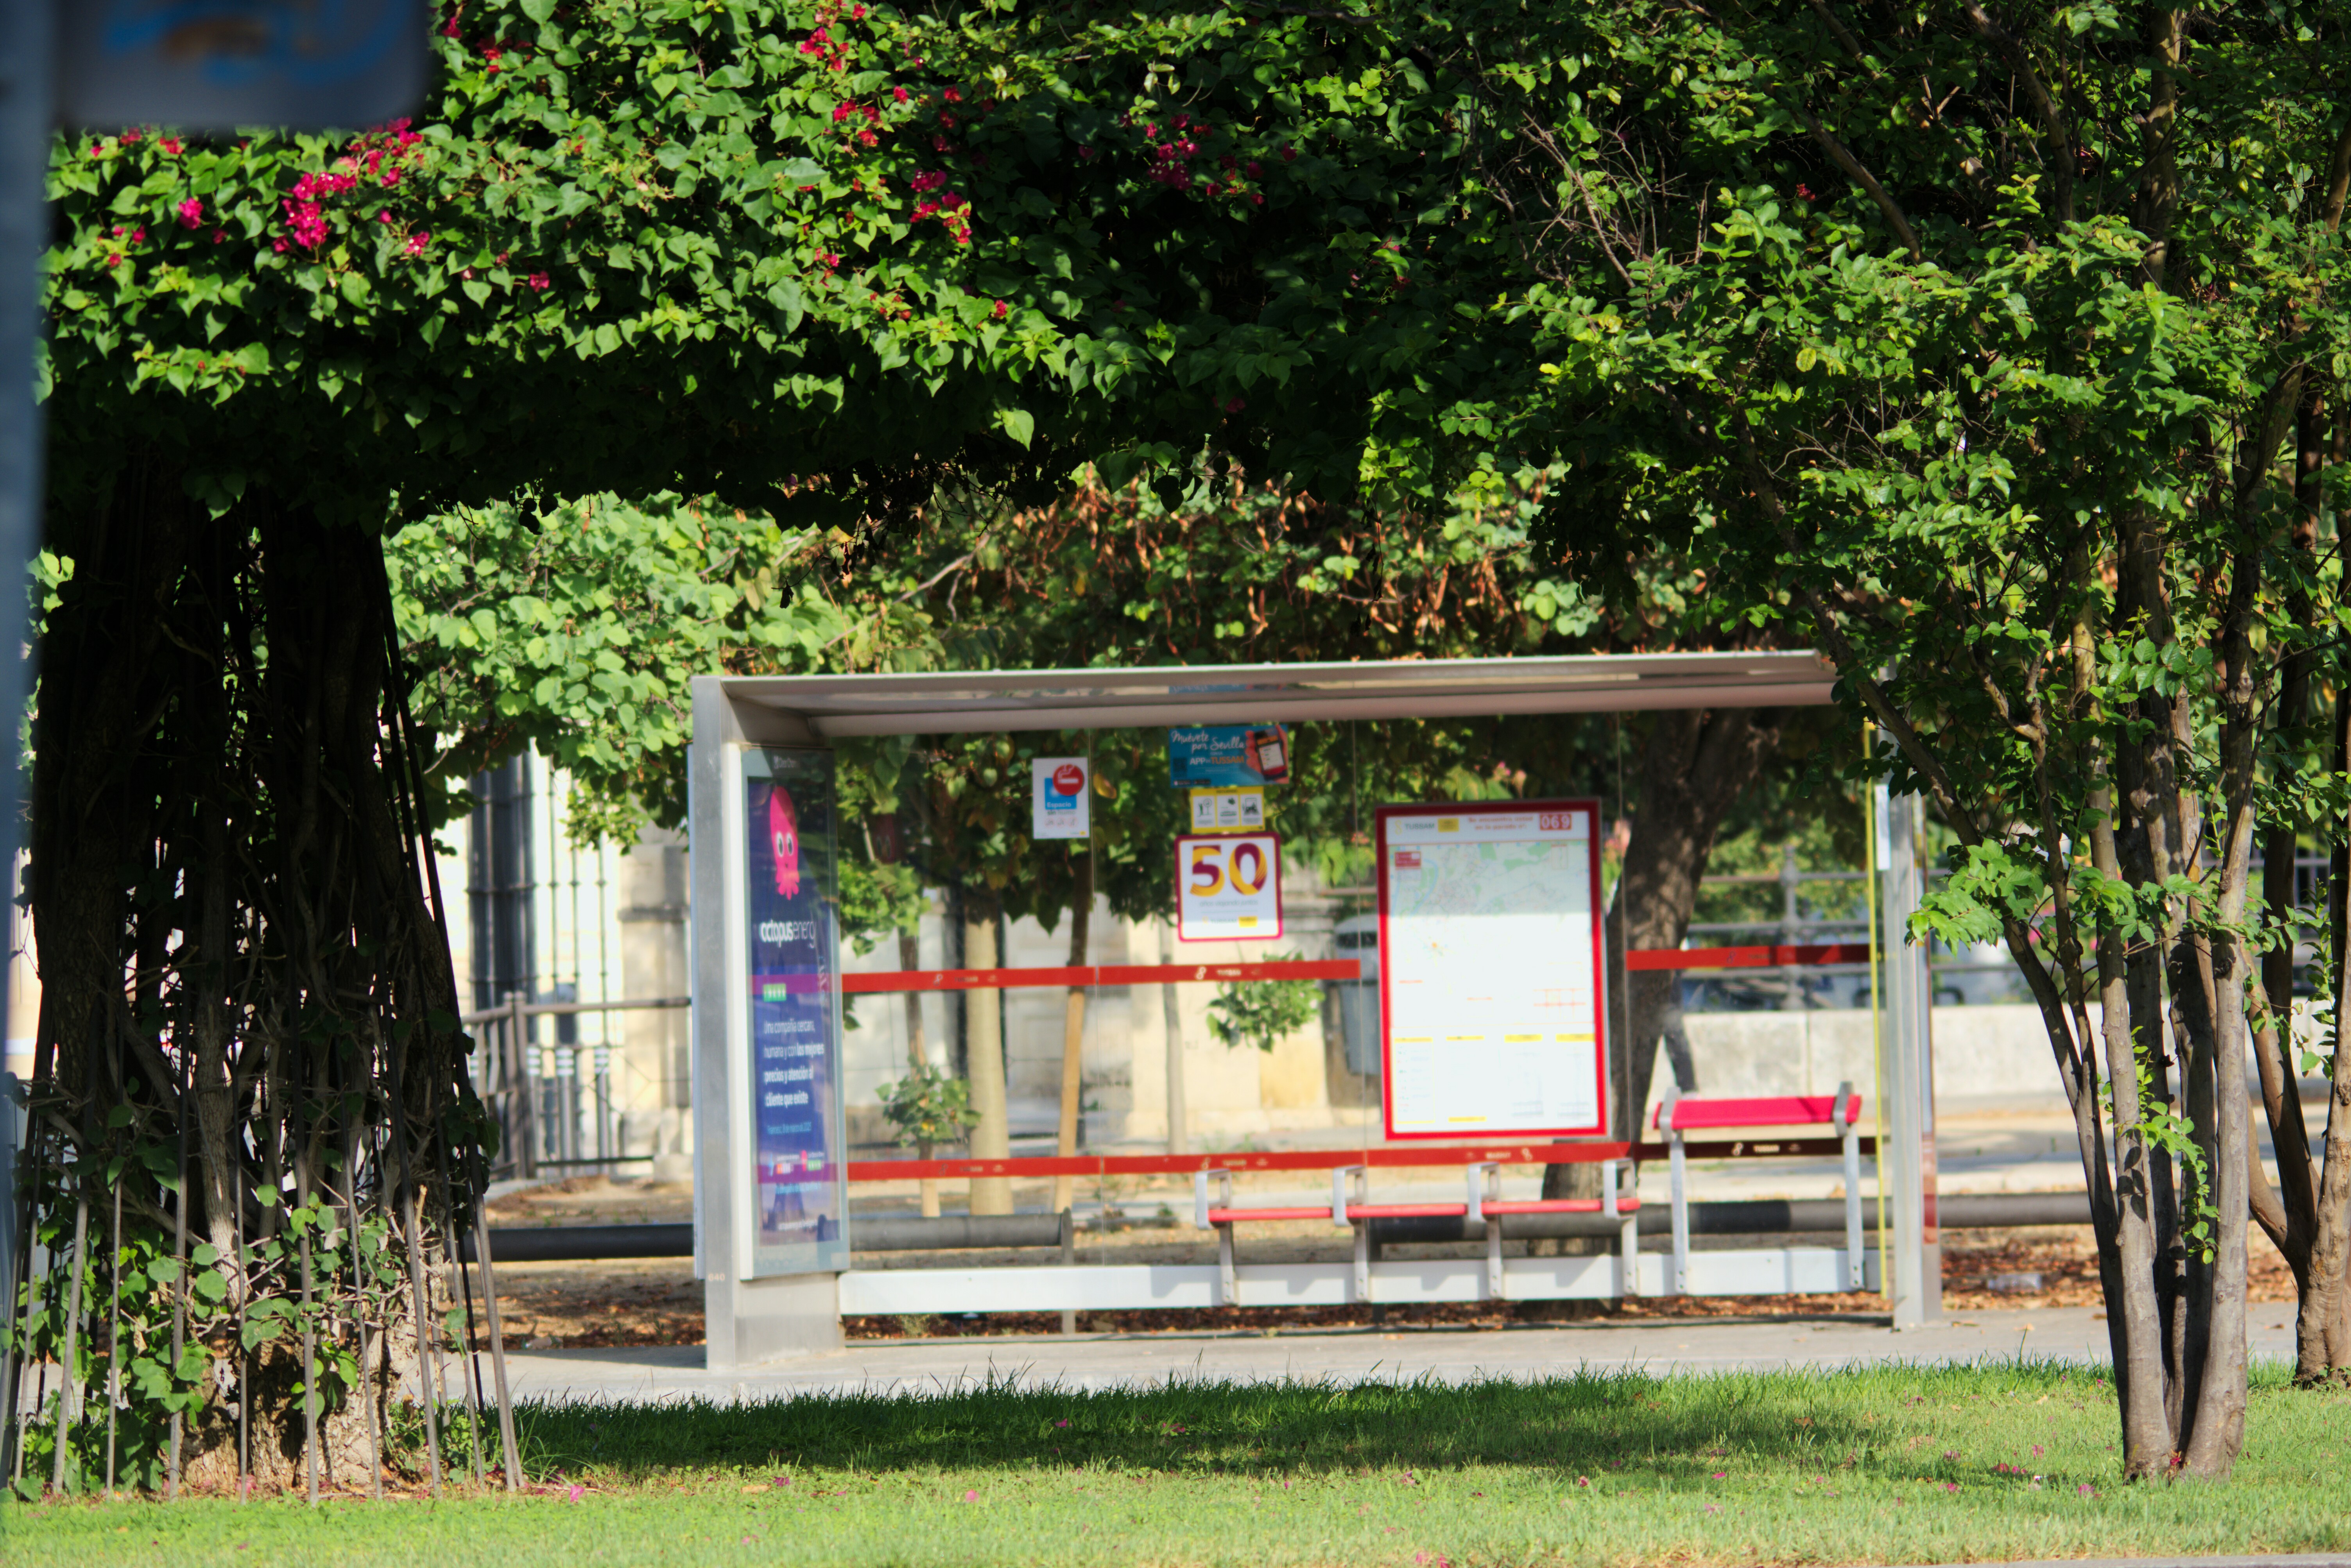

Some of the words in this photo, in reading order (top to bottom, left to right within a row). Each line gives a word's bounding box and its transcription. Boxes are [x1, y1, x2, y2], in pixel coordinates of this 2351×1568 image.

[1171, 730, 1209, 743] Muévete
[1191, 743, 1208, 753] por
[1210, 736, 1245, 751] Sevilla
[1211, 755, 1244, 764] TUSSAM
[1541, 815, 1570, 828] 069
[1190, 843, 1268, 897] 50
[764, 1020, 774, 1034] Una
[764, 1045, 783, 1058] humana
[788, 1045, 796, 1056] con
[805, 1042, 825, 1058] mejores
[765, 1067, 783, 1085] precios
[809, 1065, 814, 1079] al
[765, 1092, 783, 1107] cliente
[784, 1094, 793, 1108] que
[794, 1090, 808, 1104] existe
